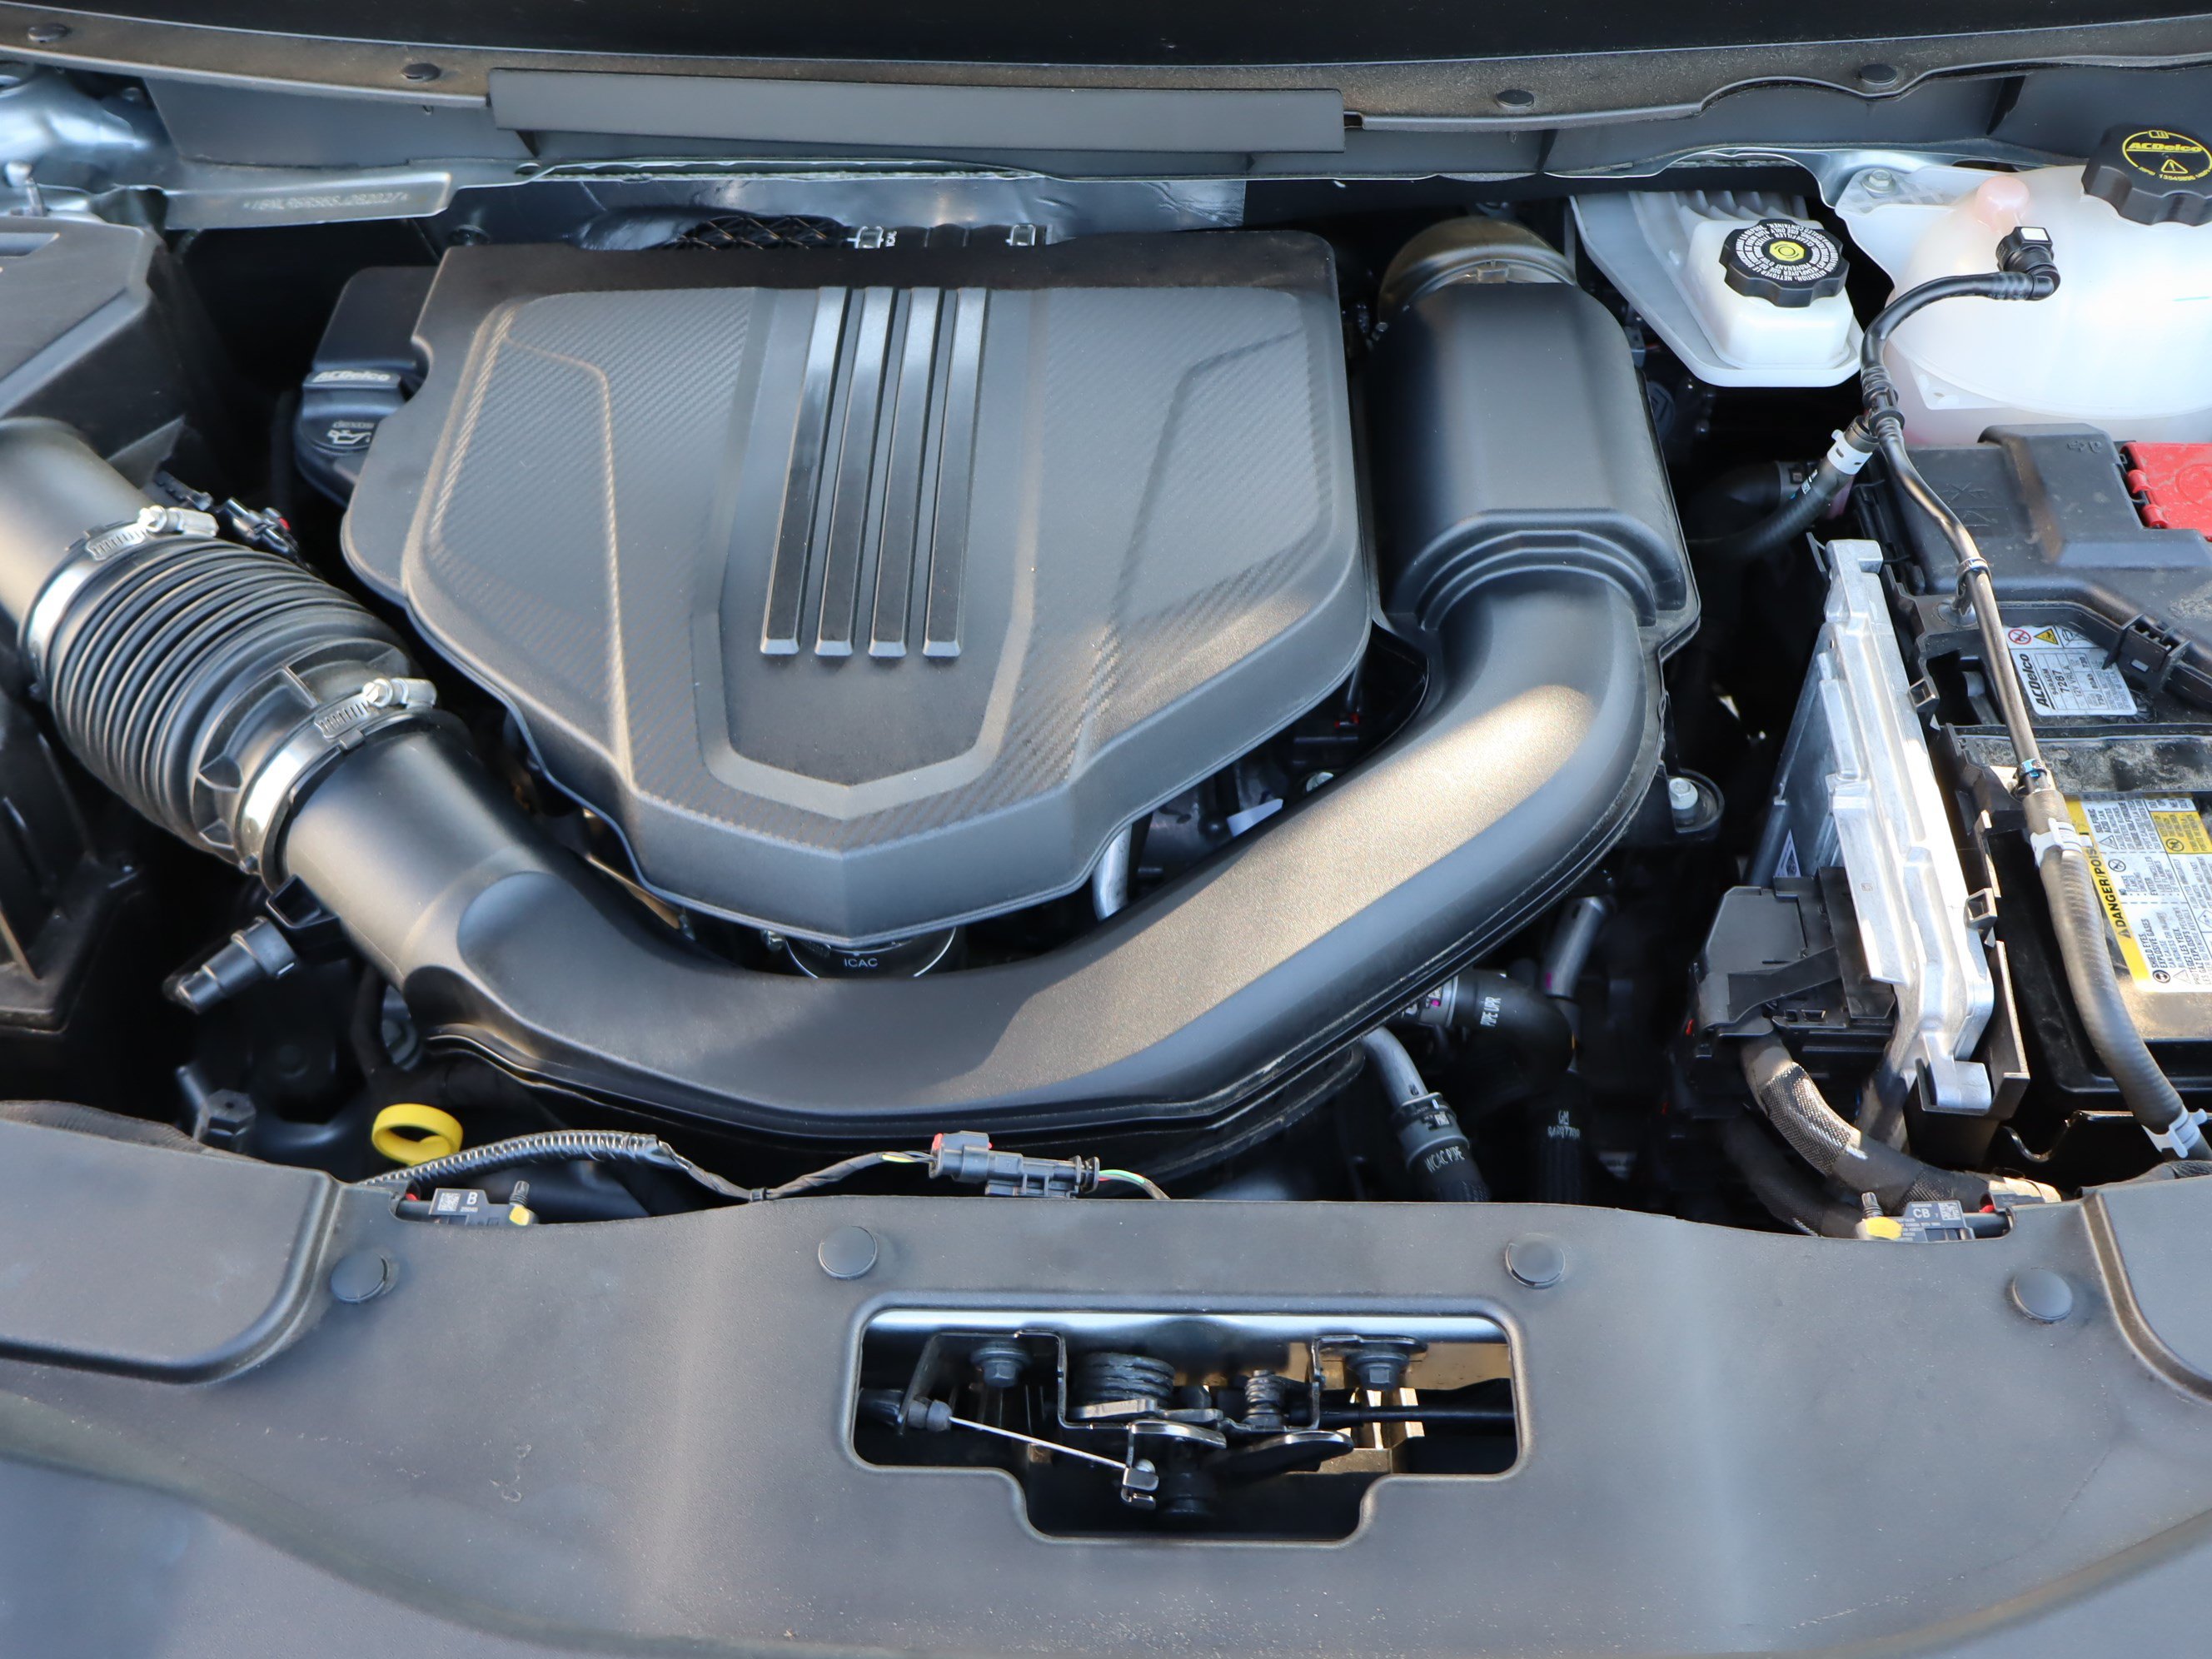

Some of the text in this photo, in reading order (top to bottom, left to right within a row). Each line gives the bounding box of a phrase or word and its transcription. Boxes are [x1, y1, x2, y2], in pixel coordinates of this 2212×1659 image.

[2126, 142, 2203, 152] ACDelco
[1761, 271, 1793, 281] NETTOYER
[2020, 653, 2050, 708] ACDelco
[2052, 670, 2070, 693] 7287
[2080, 832, 2127, 928] DANGER/POIS
[2150, 939, 2168, 968] EXPLOSIVE
[844, 958, 878, 968] ICAC
[1483, 996, 1502, 1012] UPR
[466, 1191, 478, 1205] B
[1913, 1208, 1931, 1218] CB
